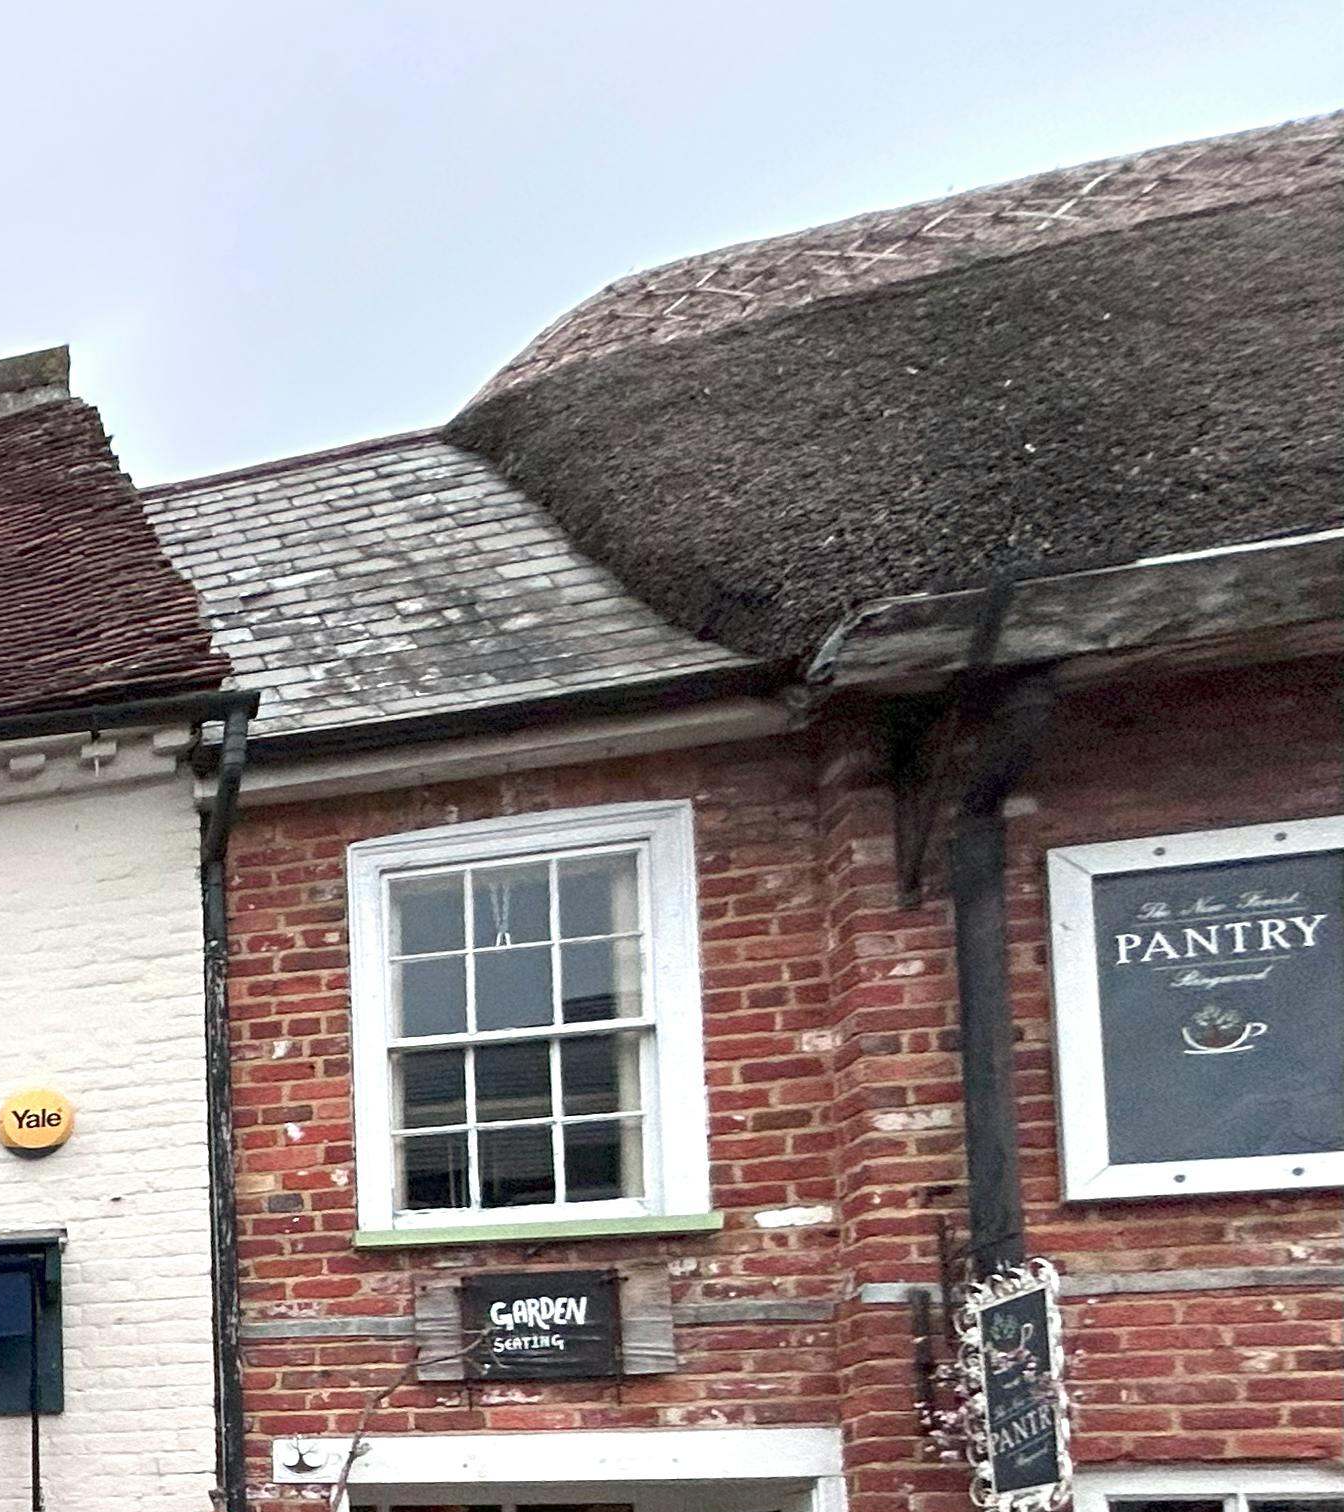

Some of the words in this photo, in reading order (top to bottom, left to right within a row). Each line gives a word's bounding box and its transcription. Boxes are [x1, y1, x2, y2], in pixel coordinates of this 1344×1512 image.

[1115, 914, 1327, 966] PANTRY
[11, 1108, 61, 1129] Yale
[490, 1296, 587, 1330] GARDEN
[493, 1334, 564, 1352] SEATING
